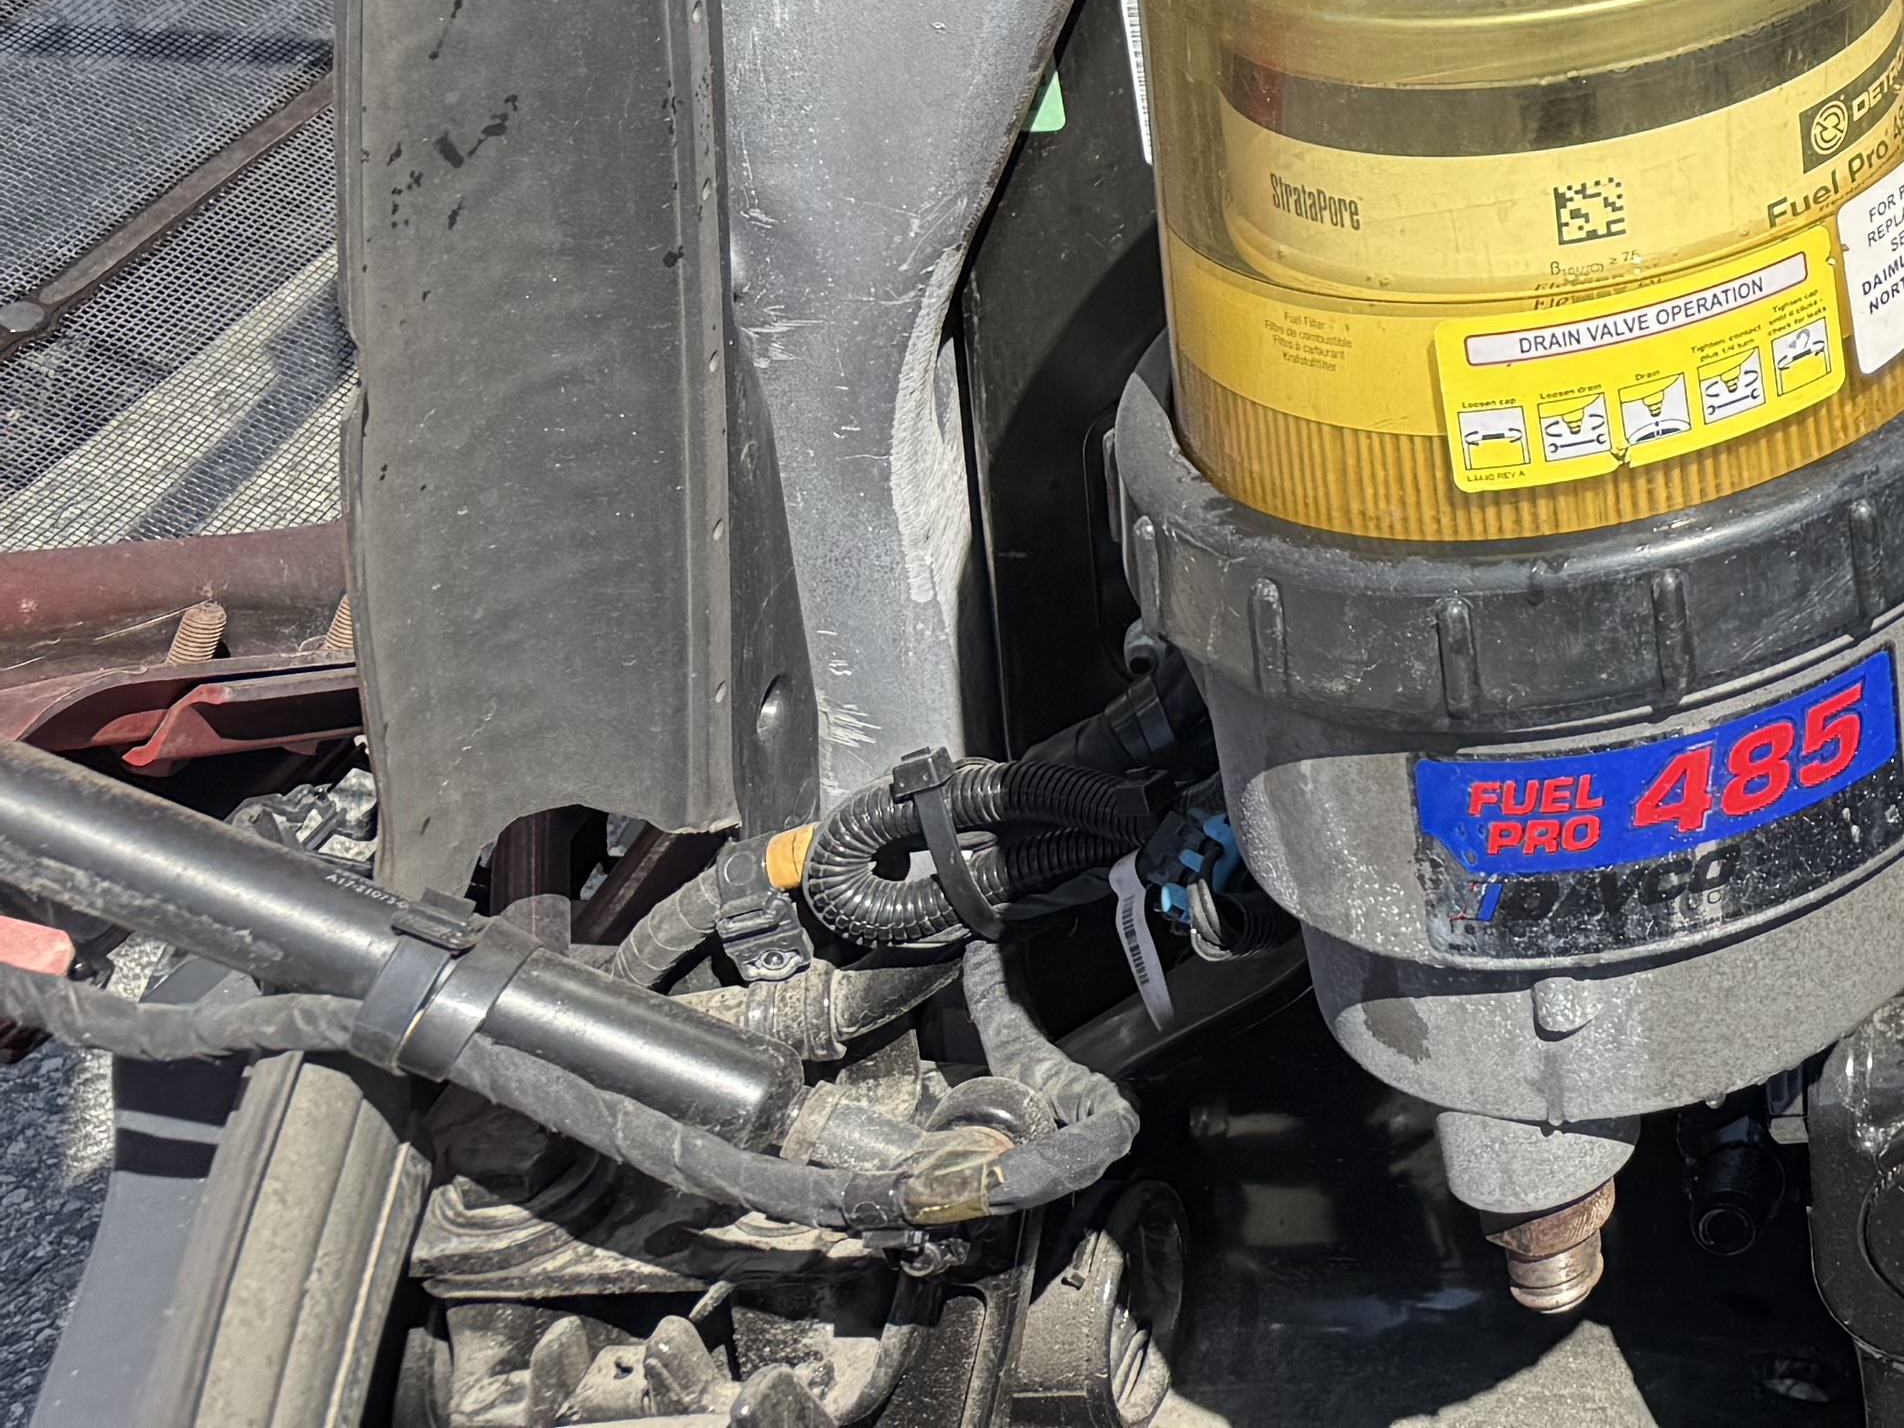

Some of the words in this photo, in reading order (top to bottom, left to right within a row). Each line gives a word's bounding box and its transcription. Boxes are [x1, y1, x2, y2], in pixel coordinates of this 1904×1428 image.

[1270, 172, 1361, 231] StrataPore
[1767, 169, 1841, 229] Fuel
[1847, 139, 1889, 183] Pro
[1868, 194, 1896, 223] FOR
[1284, 312, 1301, 325] Fuel
[1304, 315, 1326, 330] Filter
[1519, 328, 1581, 354] DRAIN
[1587, 313, 1650, 342] VALVE
[1656, 276, 1764, 326] OPERATION
[1540, 388, 1575, 400] Loosen
[1578, 382, 1602, 394] drain
[1635, 369, 1660, 381] Drain
[1462, 400, 1496, 409] Loosen
[1499, 397, 1516, 408] cap
[1468, 775, 1604, 817] FUEL
[1632, 681, 1864, 834] 485
[1486, 815, 1602, 857] PRO
